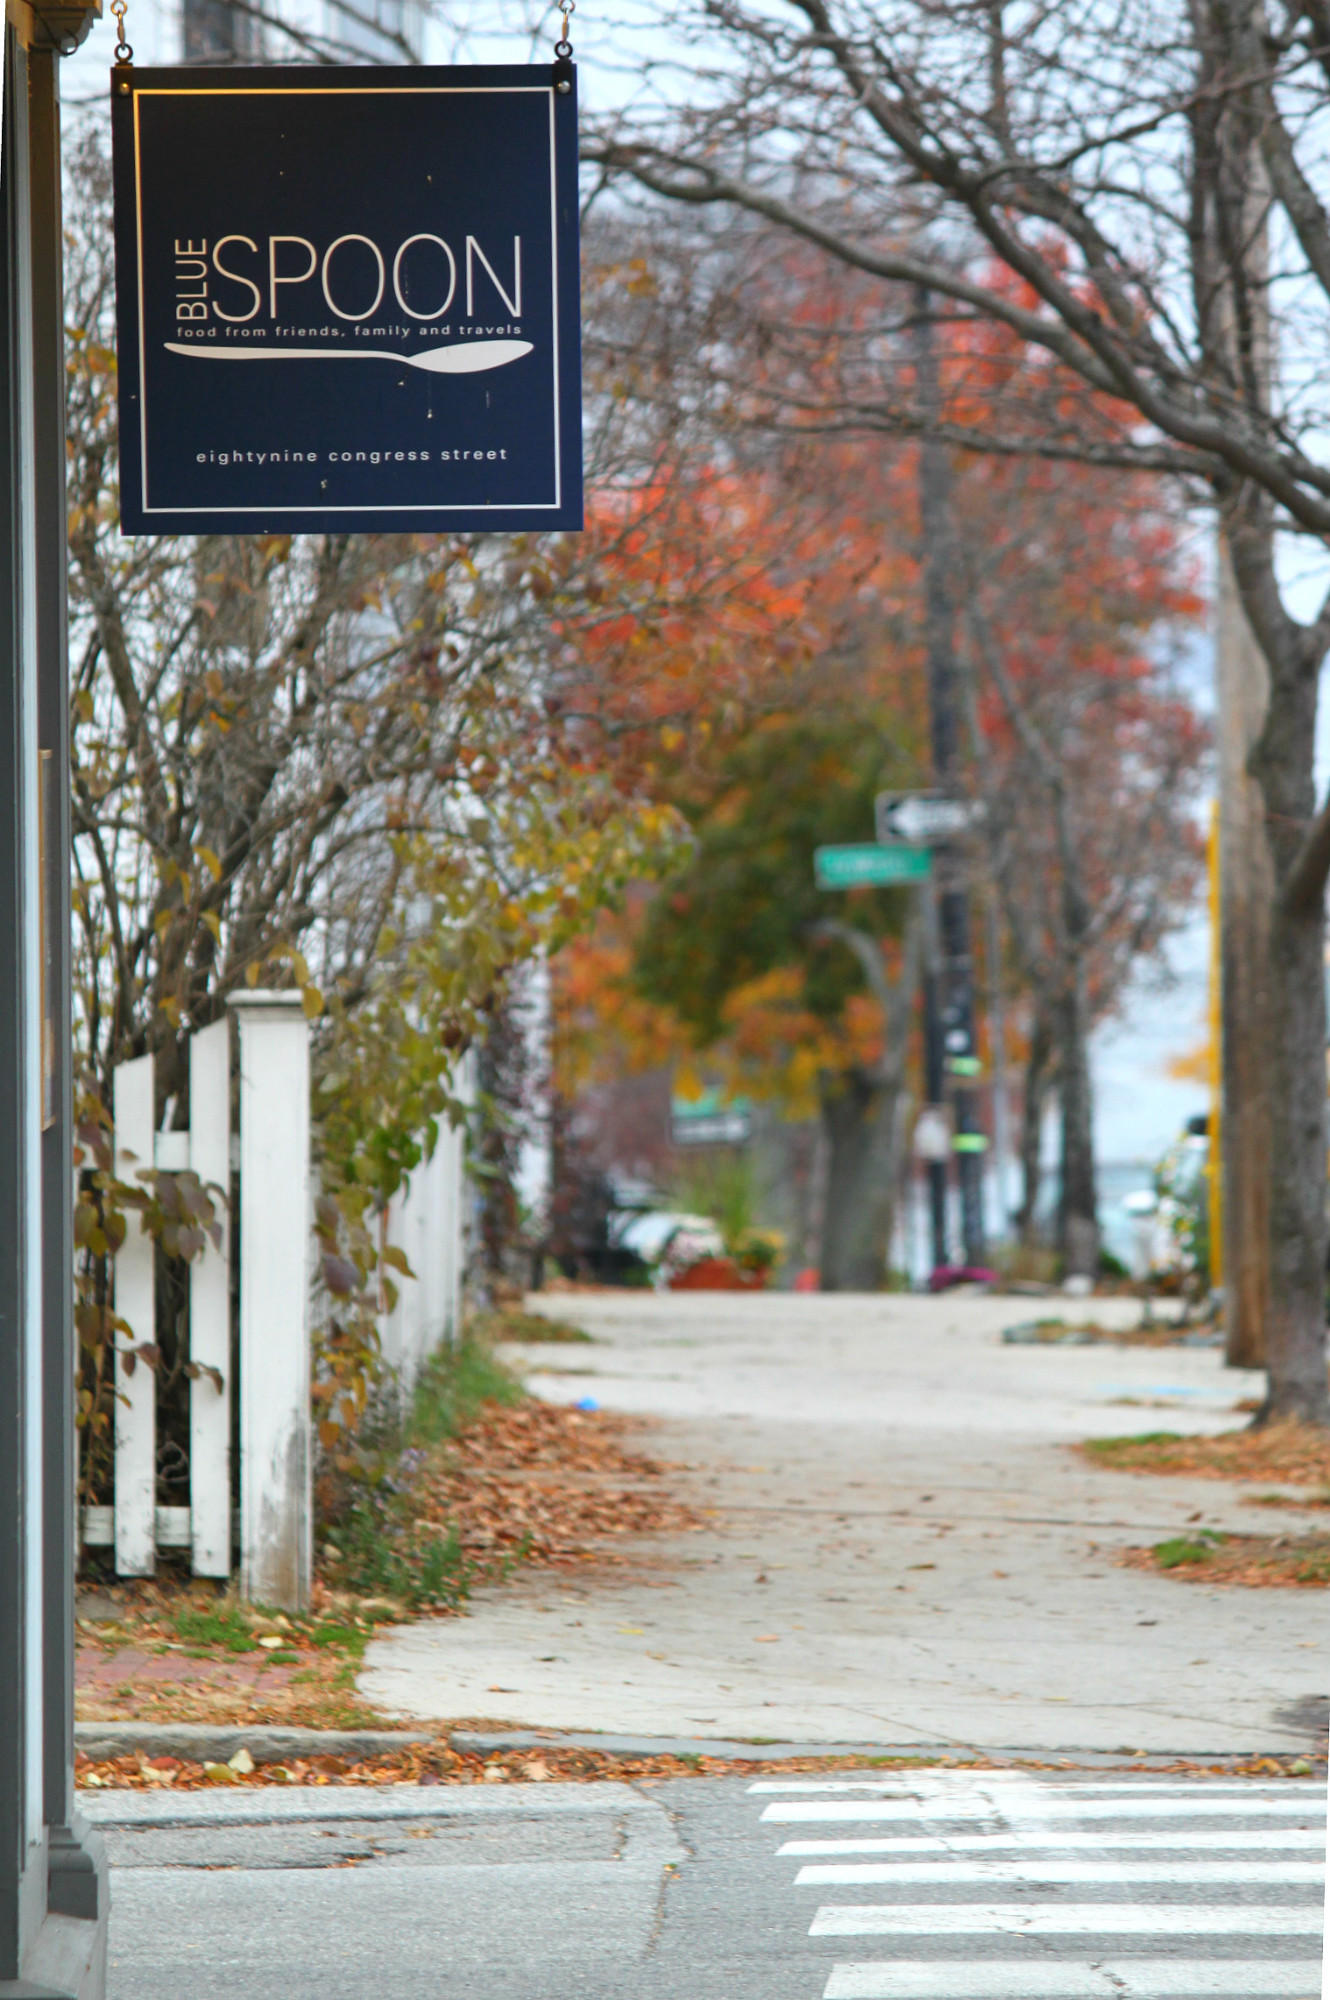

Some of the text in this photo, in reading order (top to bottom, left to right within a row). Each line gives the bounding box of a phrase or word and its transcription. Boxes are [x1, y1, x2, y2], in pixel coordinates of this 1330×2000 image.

[174, 238, 208, 321] BLUE
[211, 233, 522, 322] SPOON
[177, 323, 522, 338] food from friends, family and travels
[196, 447, 507, 465] eightynine congress street
